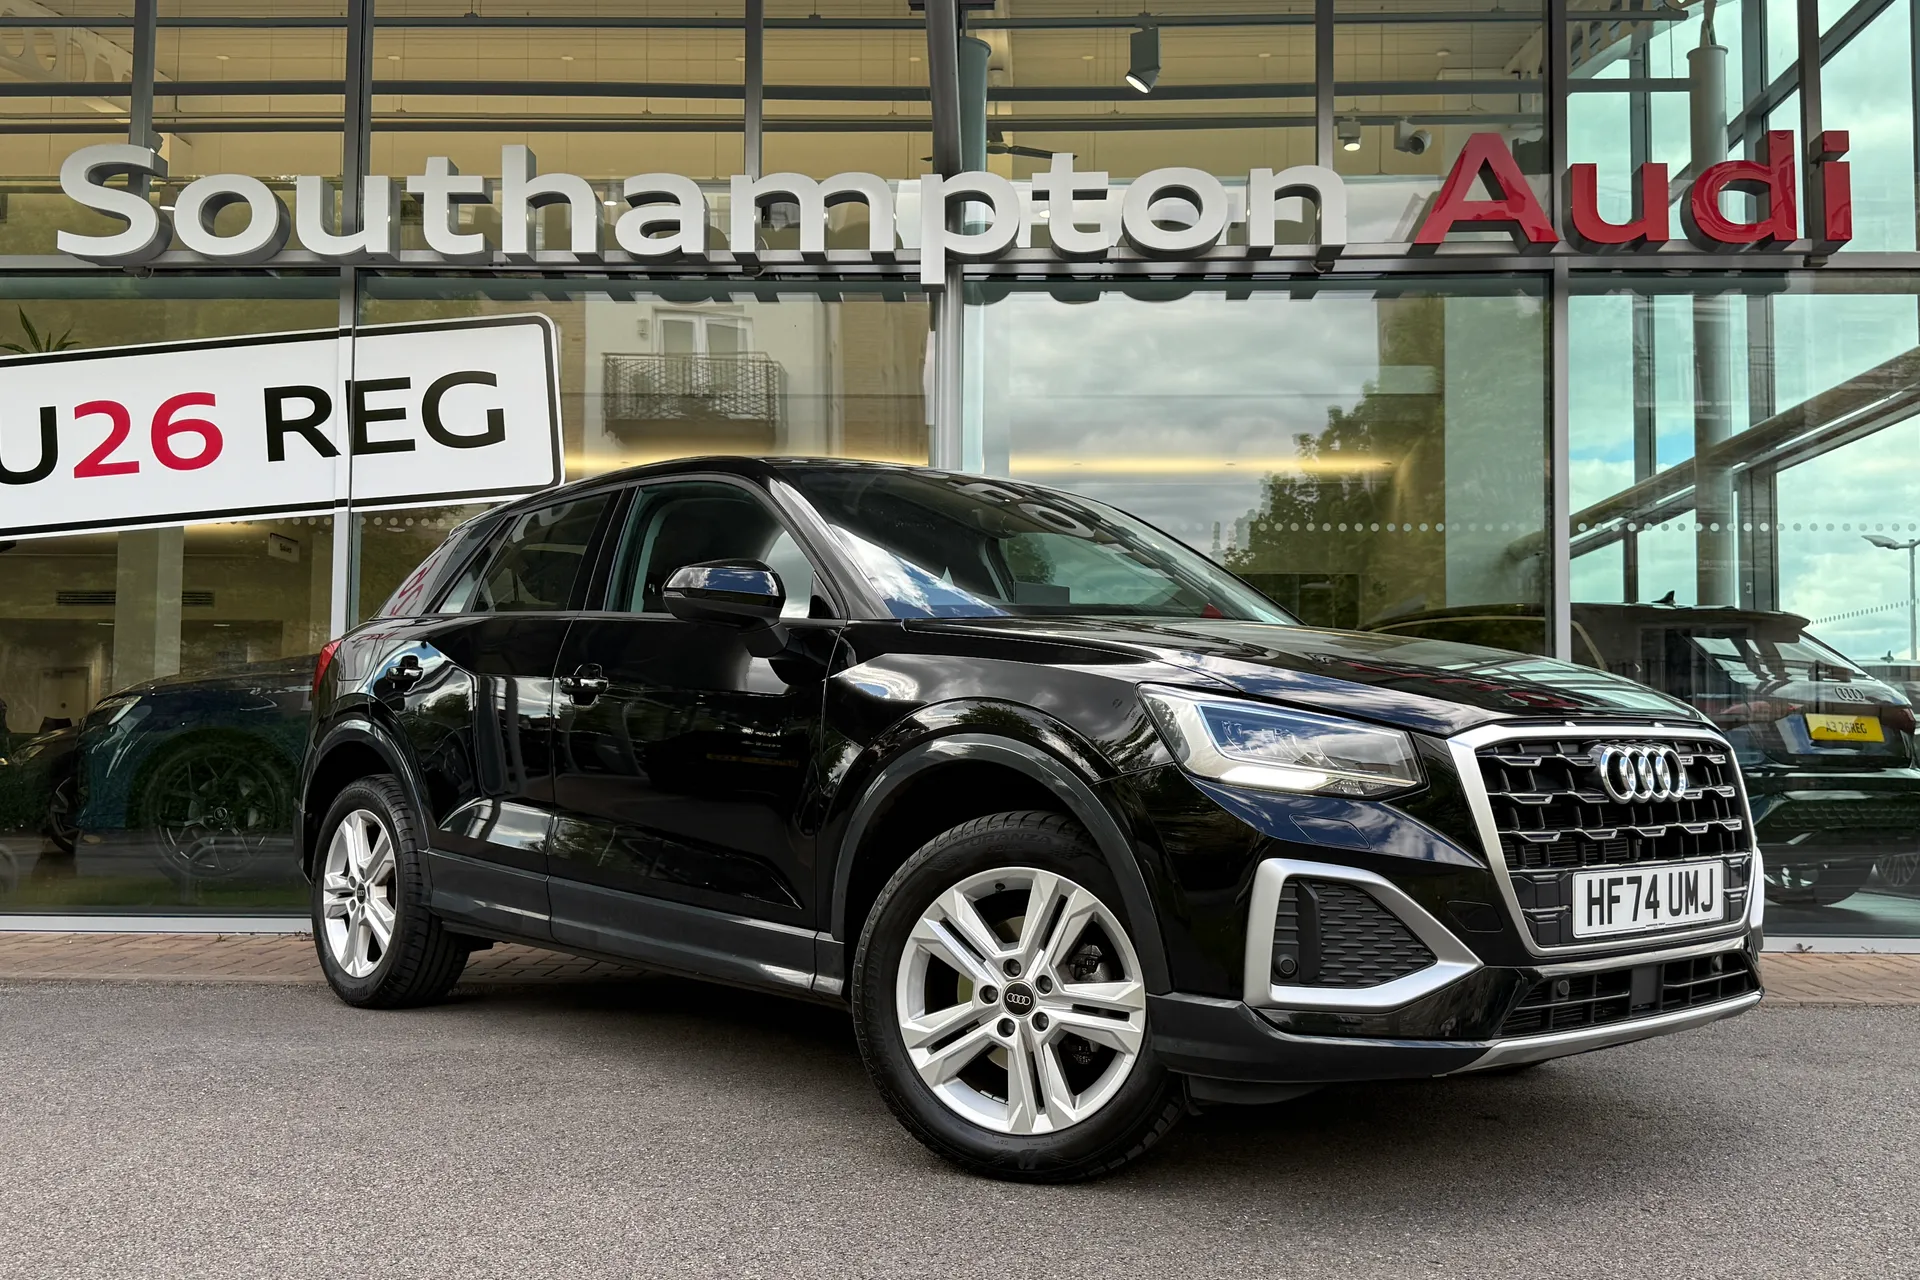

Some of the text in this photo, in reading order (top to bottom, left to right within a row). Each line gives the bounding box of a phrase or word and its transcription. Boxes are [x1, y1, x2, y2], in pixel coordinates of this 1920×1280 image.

[57, 129, 1853, 288] Southampton Audi
[0, 370, 506, 485] U26 REG
[1587, 868, 1714, 927] HF74 UMJ
